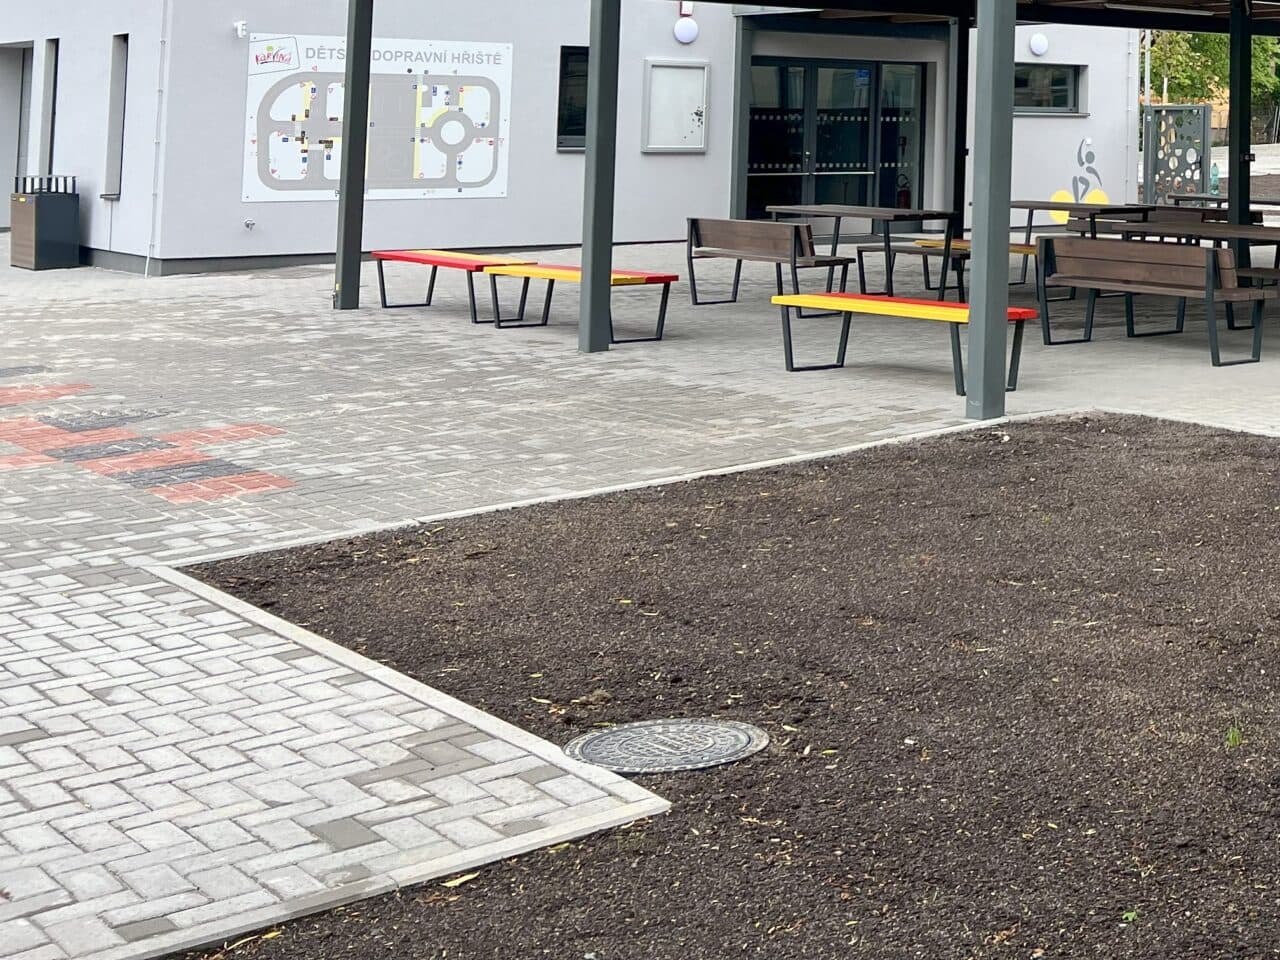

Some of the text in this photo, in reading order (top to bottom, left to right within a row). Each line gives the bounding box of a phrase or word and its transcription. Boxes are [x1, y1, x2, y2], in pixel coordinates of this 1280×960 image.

[306, 46, 502, 65] DĚTS DOPRAVNÍ HŘIŠTĚ
